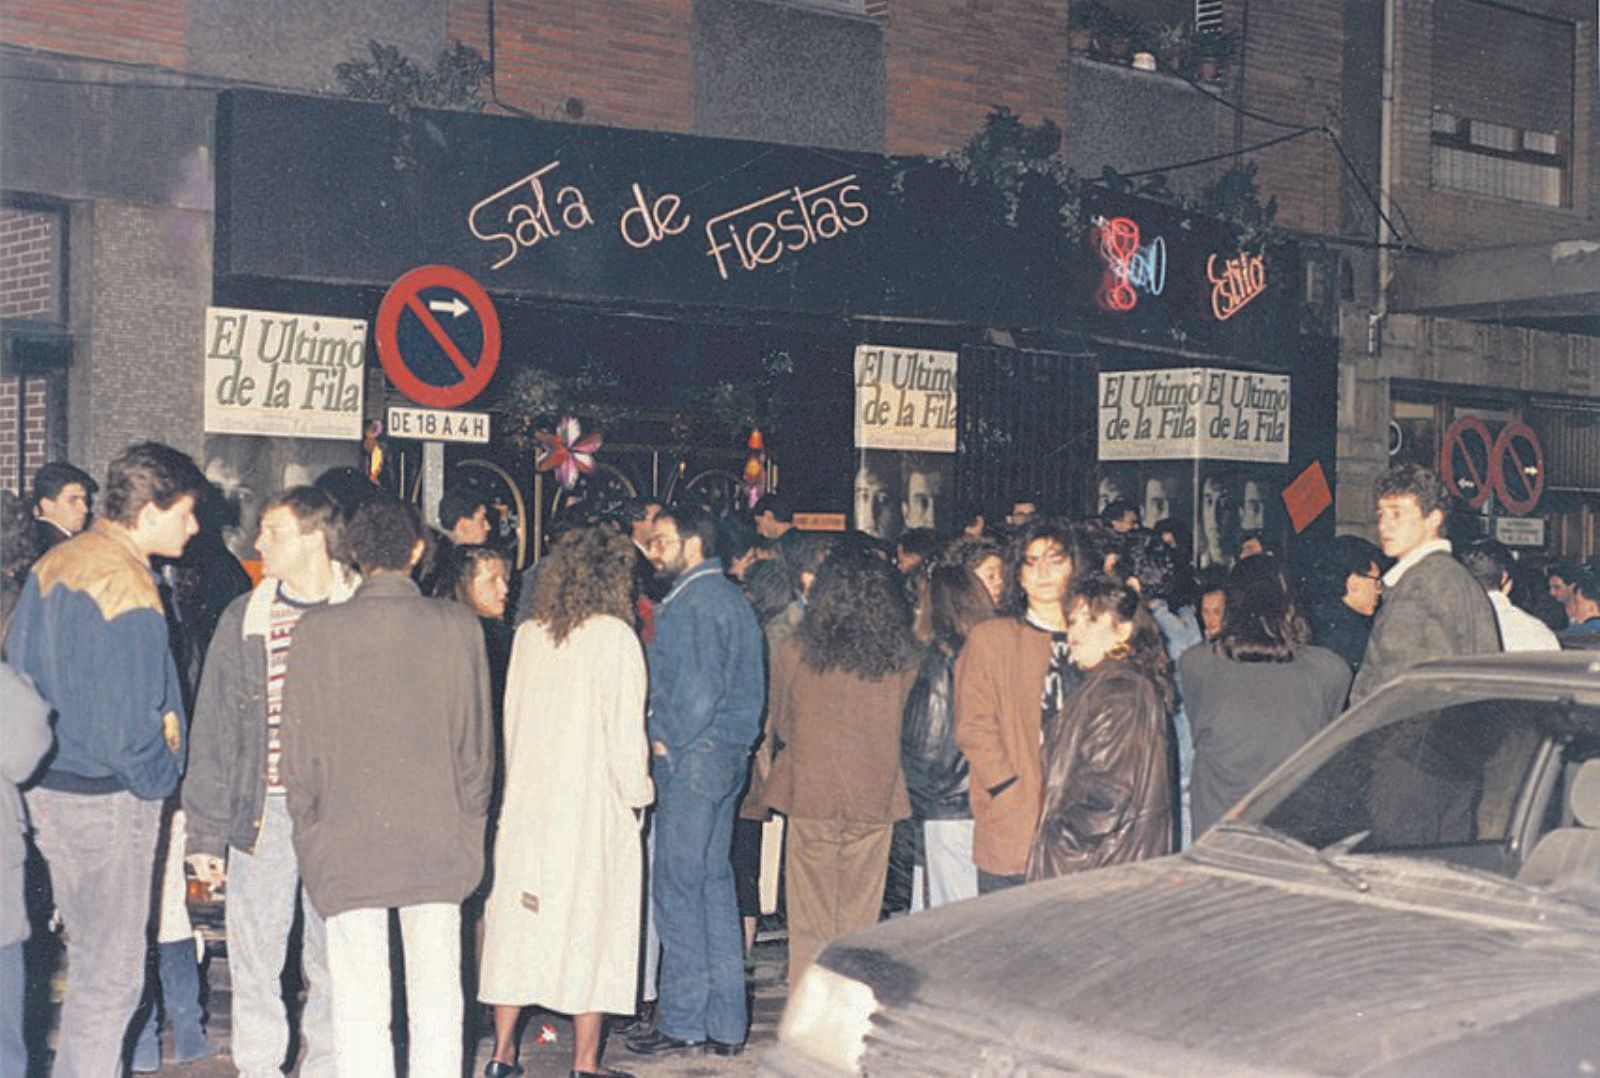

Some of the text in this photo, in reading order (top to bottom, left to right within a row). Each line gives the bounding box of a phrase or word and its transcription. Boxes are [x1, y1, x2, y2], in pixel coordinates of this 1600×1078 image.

[468, 160, 594, 270] Sala
[620, 182, 690, 249] de
[1207, 252, 1267, 321] Estilo
[208, 314, 364, 368] El Ultimo
[216, 357, 360, 412] de la Fila
[856, 350, 884, 387] El
[864, 384, 890, 425] de
[895, 389, 914, 427] la
[1102, 373, 1200, 409] El Ultimo
[1206, 373, 1287, 411] El Ultimo
[391, 412, 410, 432] DE
[417, 414, 436, 434] 18
[442, 415, 452, 435] A
[1106, 402, 1196, 440] de la Fila
[1210, 405, 1285, 442] de la Fila
